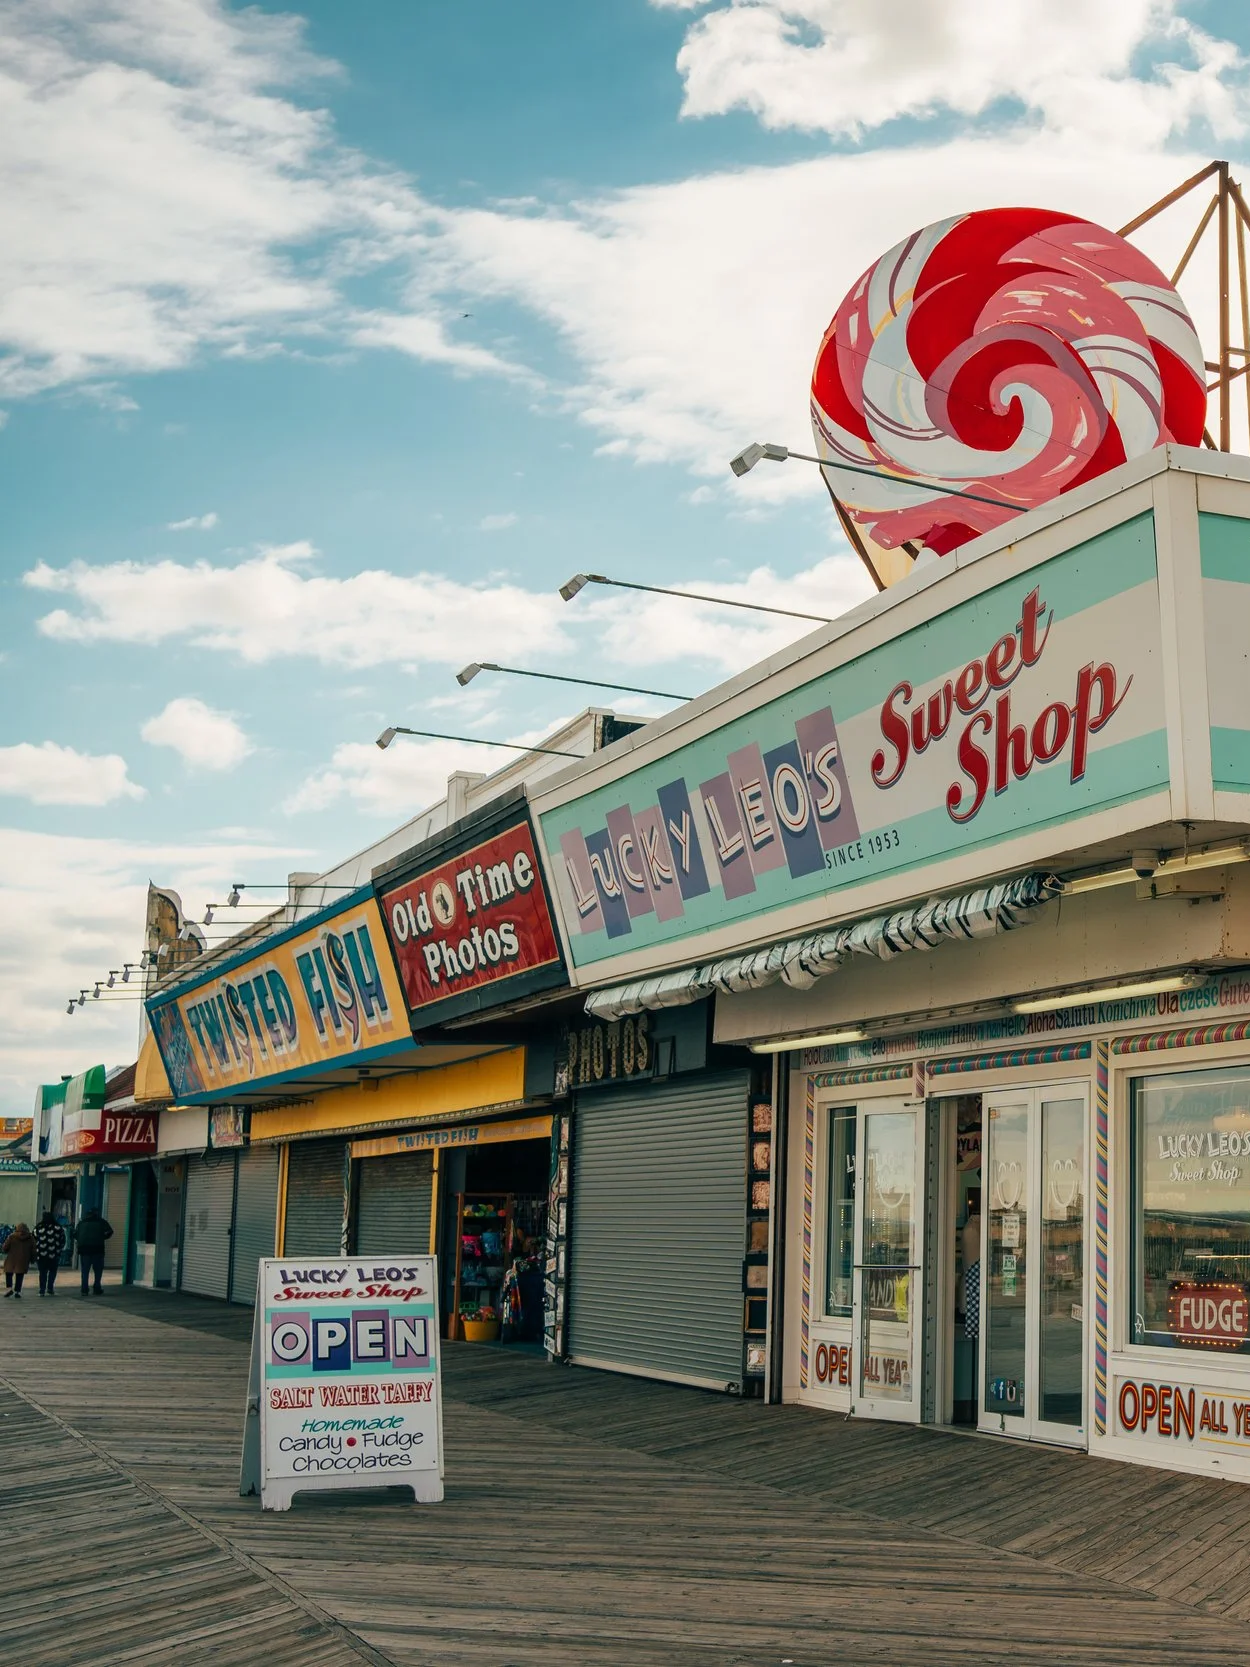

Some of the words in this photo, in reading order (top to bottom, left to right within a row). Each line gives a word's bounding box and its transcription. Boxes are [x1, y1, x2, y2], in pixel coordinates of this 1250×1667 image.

[870, 585, 1054, 789] Sweet
[945, 660, 1134, 822] Shop
[563, 804, 692, 918] LUCKY
[703, 741, 842, 862] LEO'S
[825, 843, 865, 870] SINCE
[868, 830, 902, 856] 1953
[392, 891, 434, 943] Old
[456, 852, 536, 914] Time
[422, 922, 520, 985] Photos
[185, 968, 298, 1076] TWISTED
[294, 924, 391, 1050] FISH
[917, 1027, 952, 1054] Bonjour
[952, 1024, 977, 1044] Hallo
[1001, 1016, 1026, 1036] Hello
[1027, 1010, 1056, 1034] Aloha
[1055, 1005, 1095, 1030] Salutu
[1097, 996, 1156, 1024] Konichiwa
[1157, 991, 1179, 1015] Ola
[567, 1013, 649, 1085] PHOTOS
[103, 1116, 156, 1144] PIZZA
[397, 1129, 450, 1149] TWISTED
[451, 1127, 480, 1144] FISH
[1158, 1135, 1204, 1160] LUCKY
[1170, 1161, 1205, 1182] Sweet
[1207, 1159, 1241, 1187] Shop
[274, 1286, 353, 1300] Sweet
[356, 1283, 428, 1302] Shop
[280, 1268, 348, 1284] LUCKY
[356, 1267, 419, 1281] LEO'S
[1180, 1297, 1244, 1332] FUDGE
[271, 1318, 427, 1362] OPEN
[863, 1355, 881, 1383] ALL
[270, 1386, 315, 1410] SALT
[318, 1384, 378, 1407] WATER
[381, 1381, 433, 1404] TAFFY
[1119, 1380, 1196, 1440] OPEN
[301, 1415, 405, 1433] Homemade
[1199, 1399, 1228, 1434] ALL
[279, 1434, 342, 1454] Candy
[362, 1431, 424, 1451] Fudge
[292, 1452, 412, 1472] Chocolates
